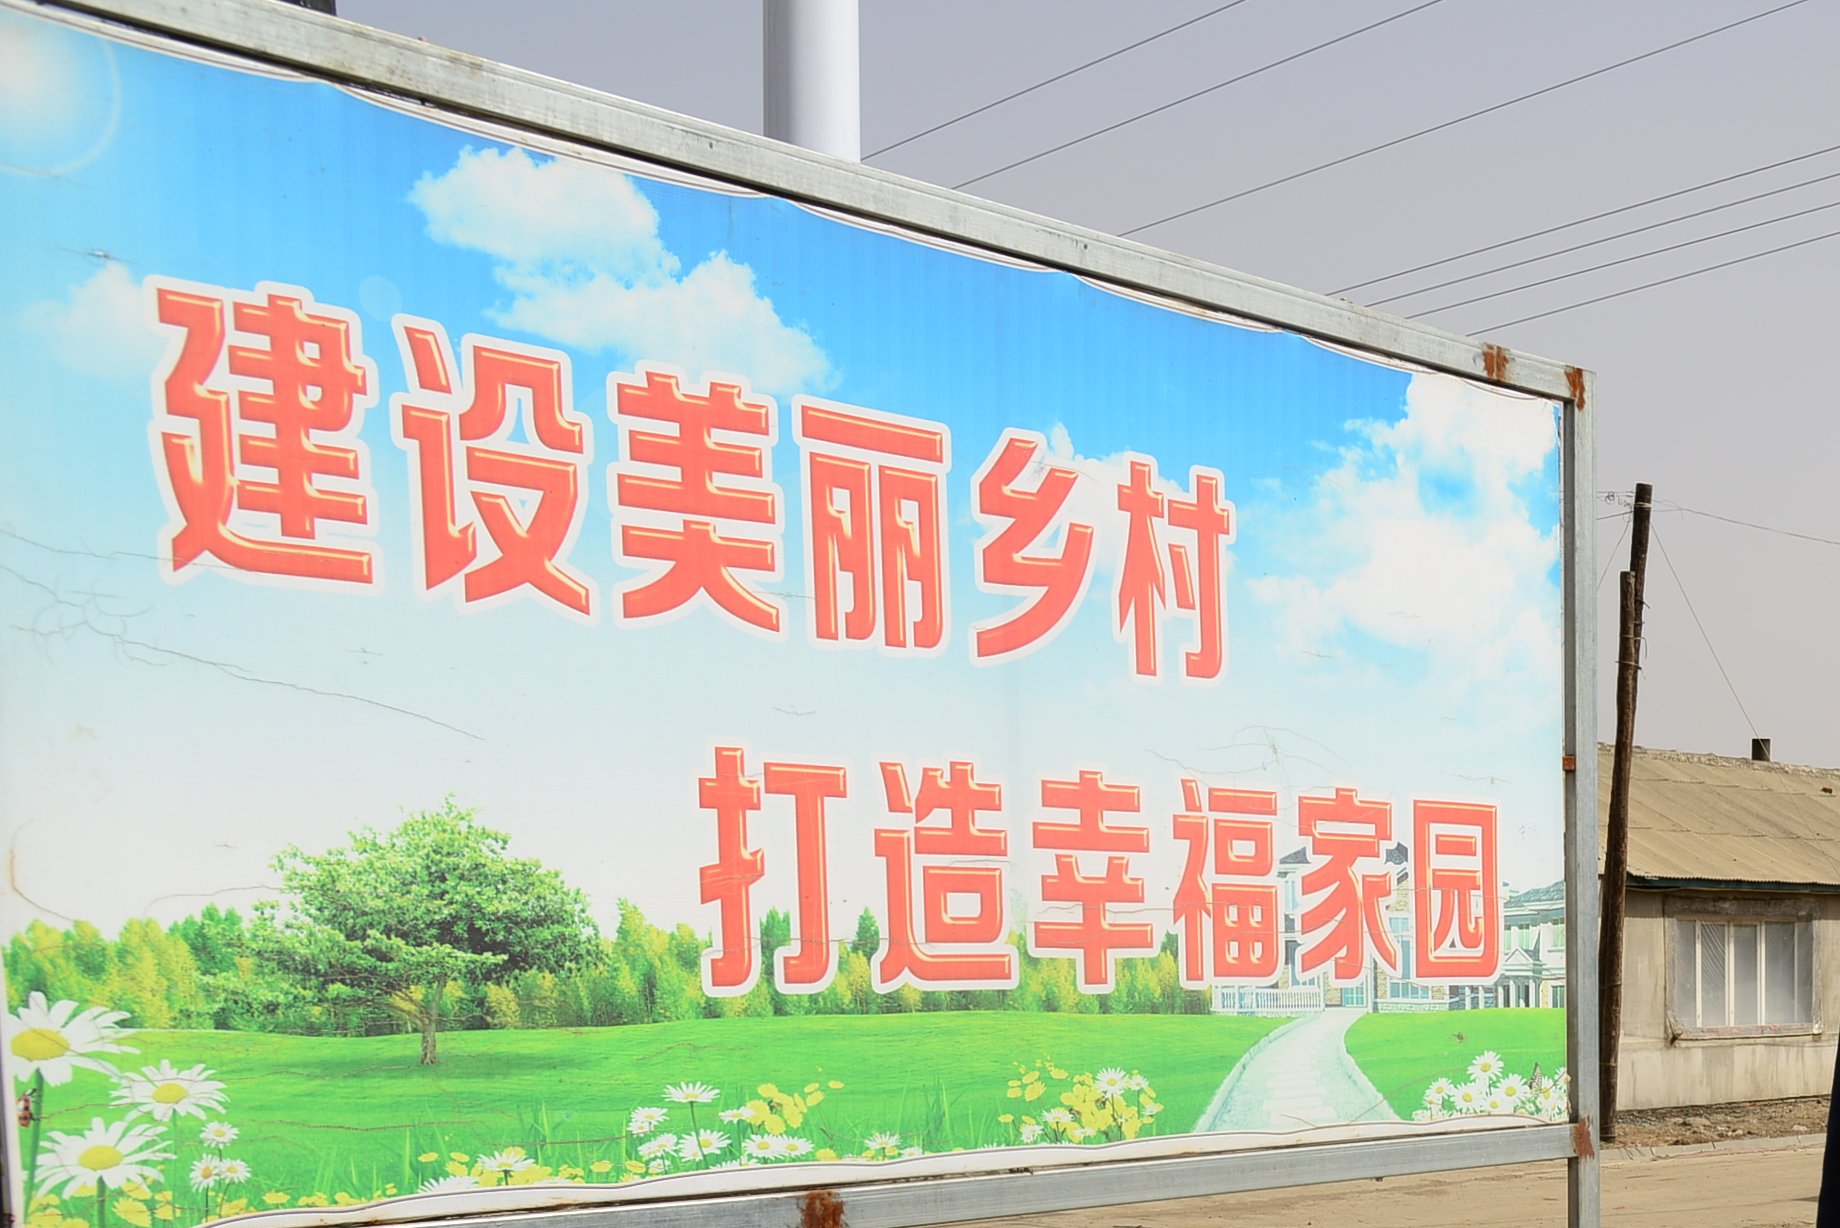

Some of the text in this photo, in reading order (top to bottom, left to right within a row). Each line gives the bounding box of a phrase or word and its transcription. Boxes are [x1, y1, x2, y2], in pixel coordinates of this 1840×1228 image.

[156, 286, 1231, 681] 建设美丽乡村
[697, 745, 1500, 988] 打造幸福家园
